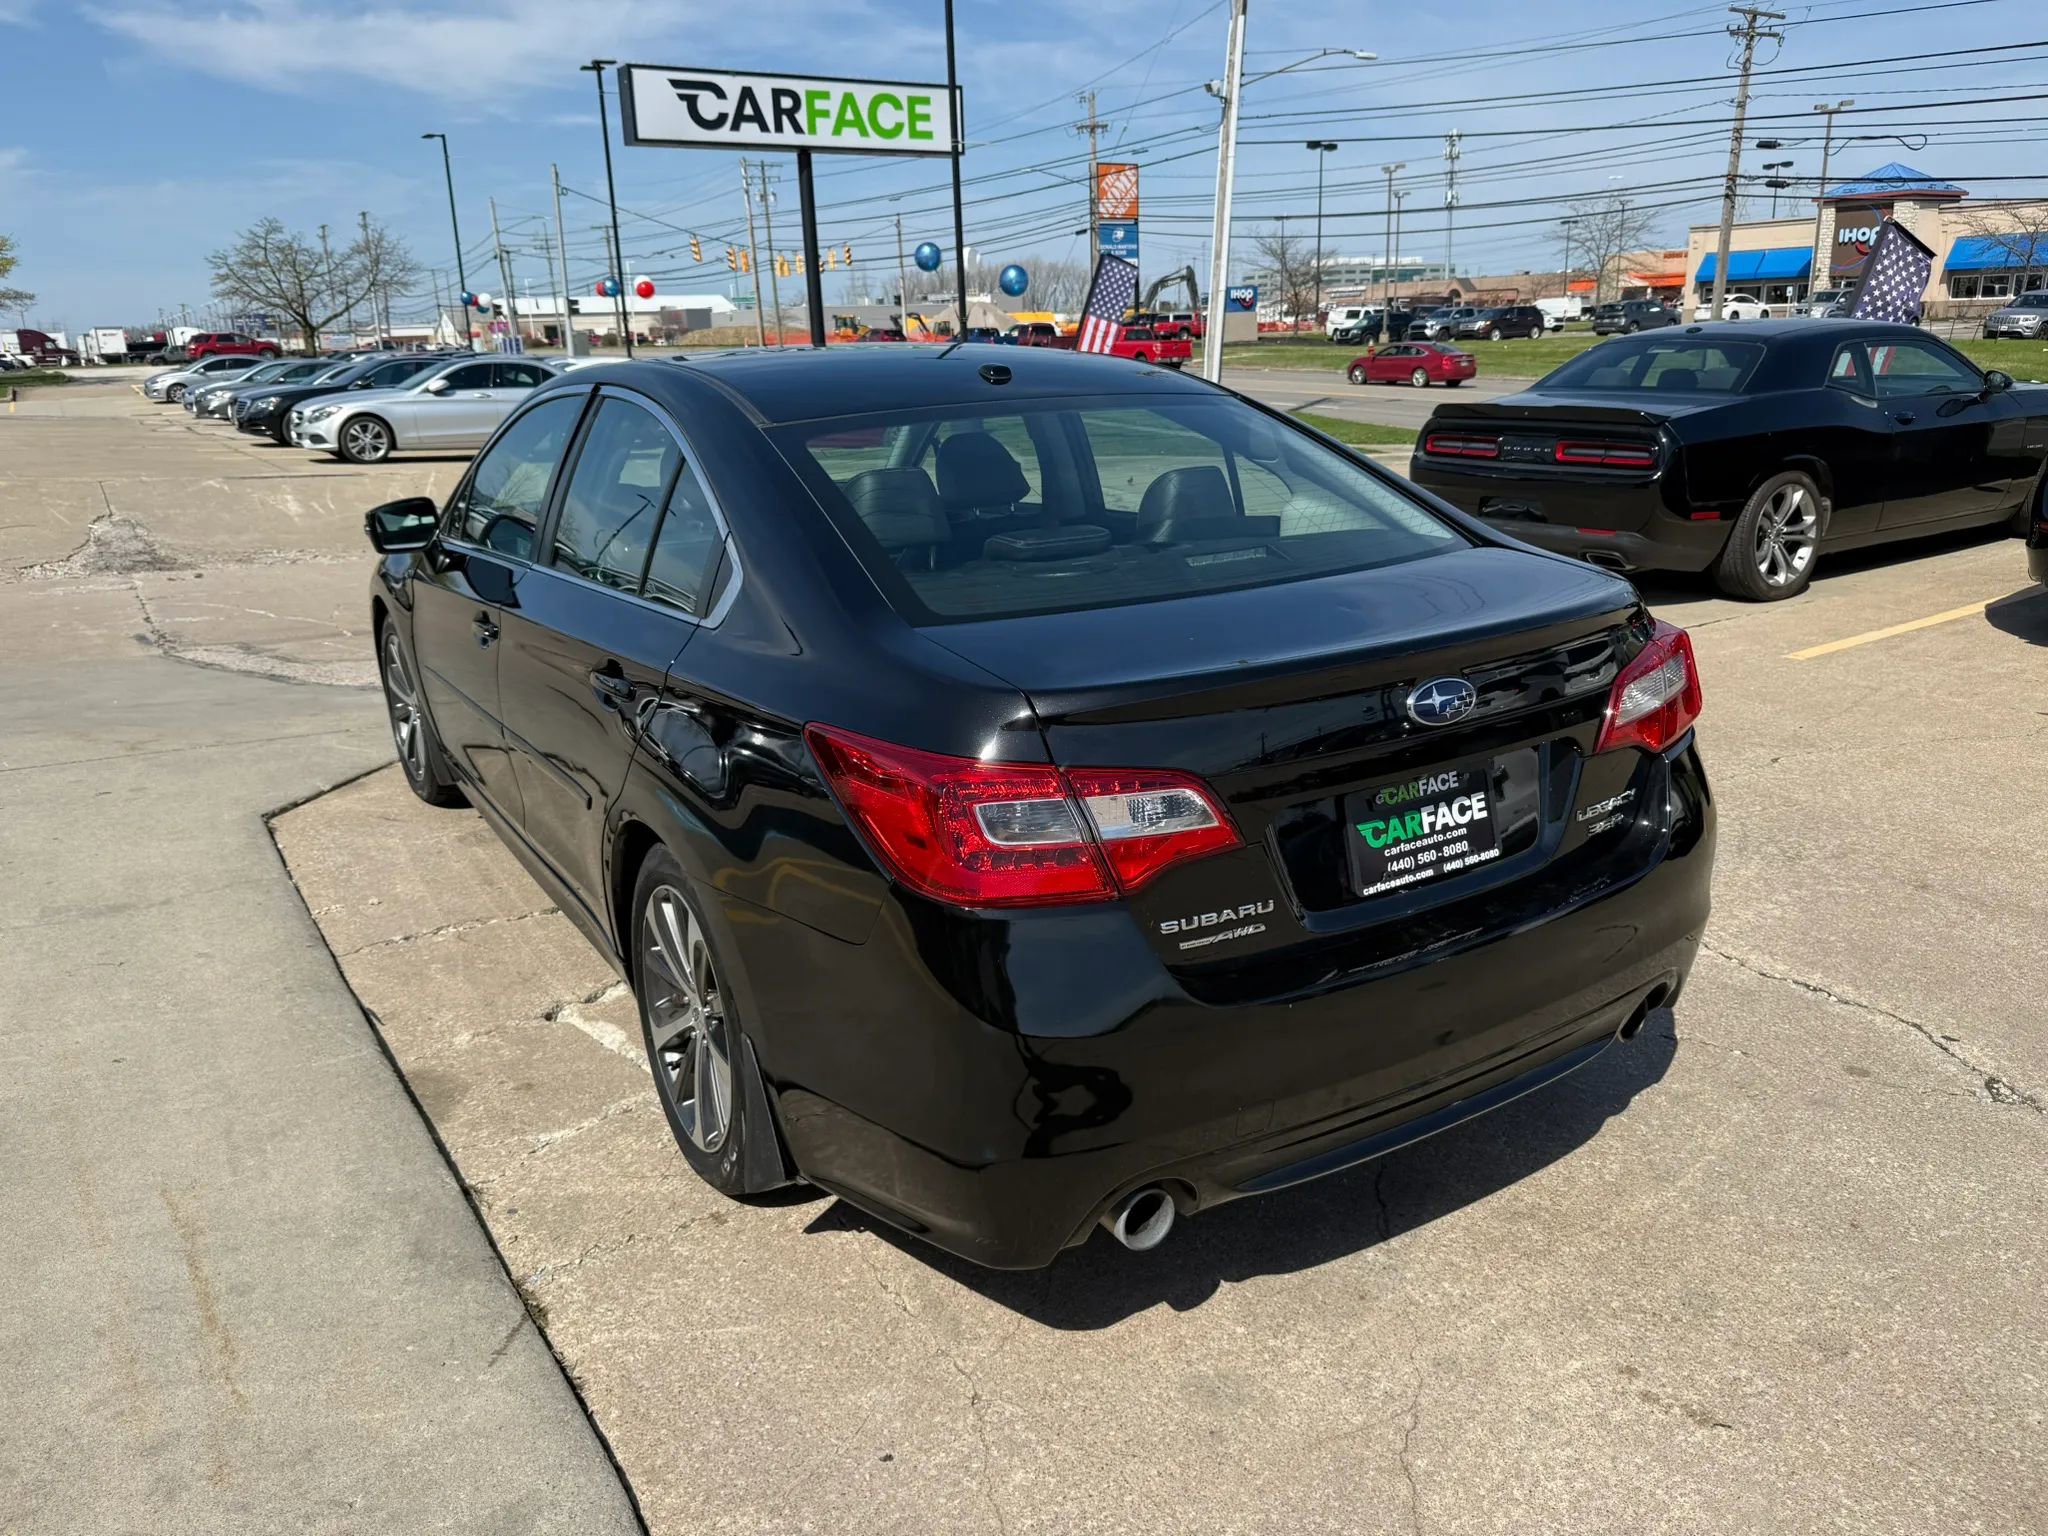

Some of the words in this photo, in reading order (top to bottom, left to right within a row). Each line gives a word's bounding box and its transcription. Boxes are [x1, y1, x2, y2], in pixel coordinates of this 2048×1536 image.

[667, 78, 934, 140] CARFACE
[1379, 771, 1459, 806] CARFACE
[1356, 792, 1488, 848] CARFACE
[1384, 827, 1467, 857] carfaceauto.com
[1363, 869, 1434, 896] carfaceauto.com
[1443, 859, 1464, 874] (440)
[1464, 848, 1500, 866] 560-8080
[1387, 855, 1415, 873] (440)
[1160, 899, 1275, 935] SUBARU
[1212, 923, 1266, 943] AWD
